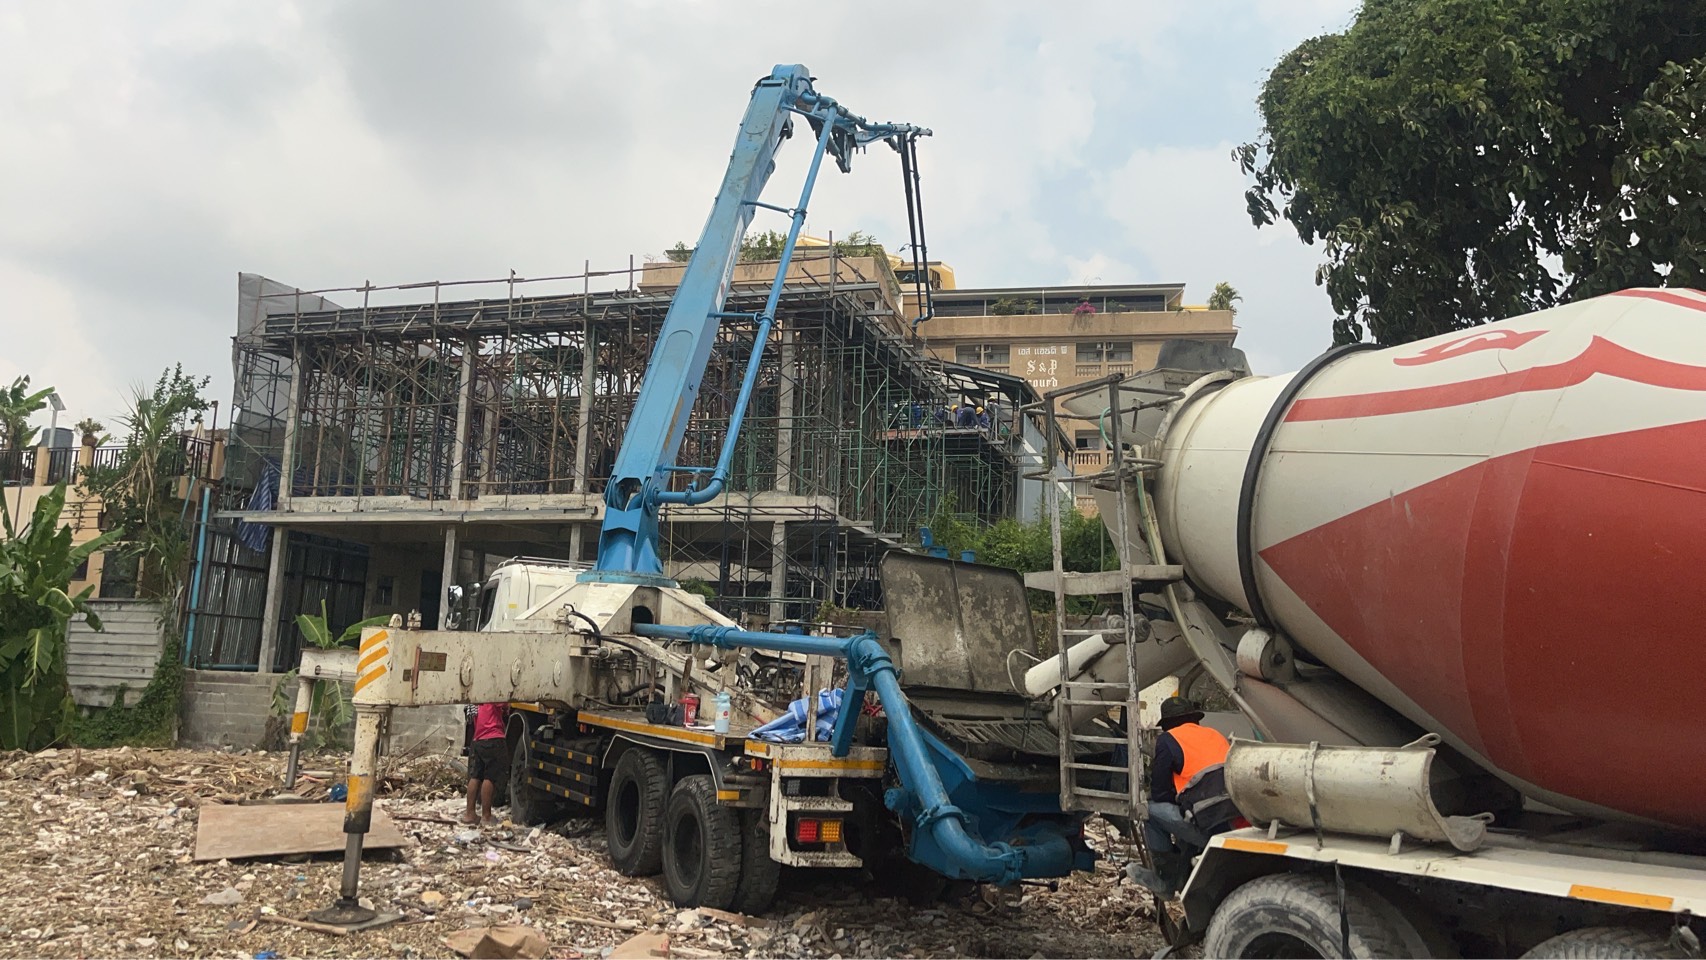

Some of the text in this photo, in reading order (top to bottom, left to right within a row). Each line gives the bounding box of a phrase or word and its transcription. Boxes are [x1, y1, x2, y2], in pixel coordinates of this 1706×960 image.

[1026, 359, 1058, 376] S & P
